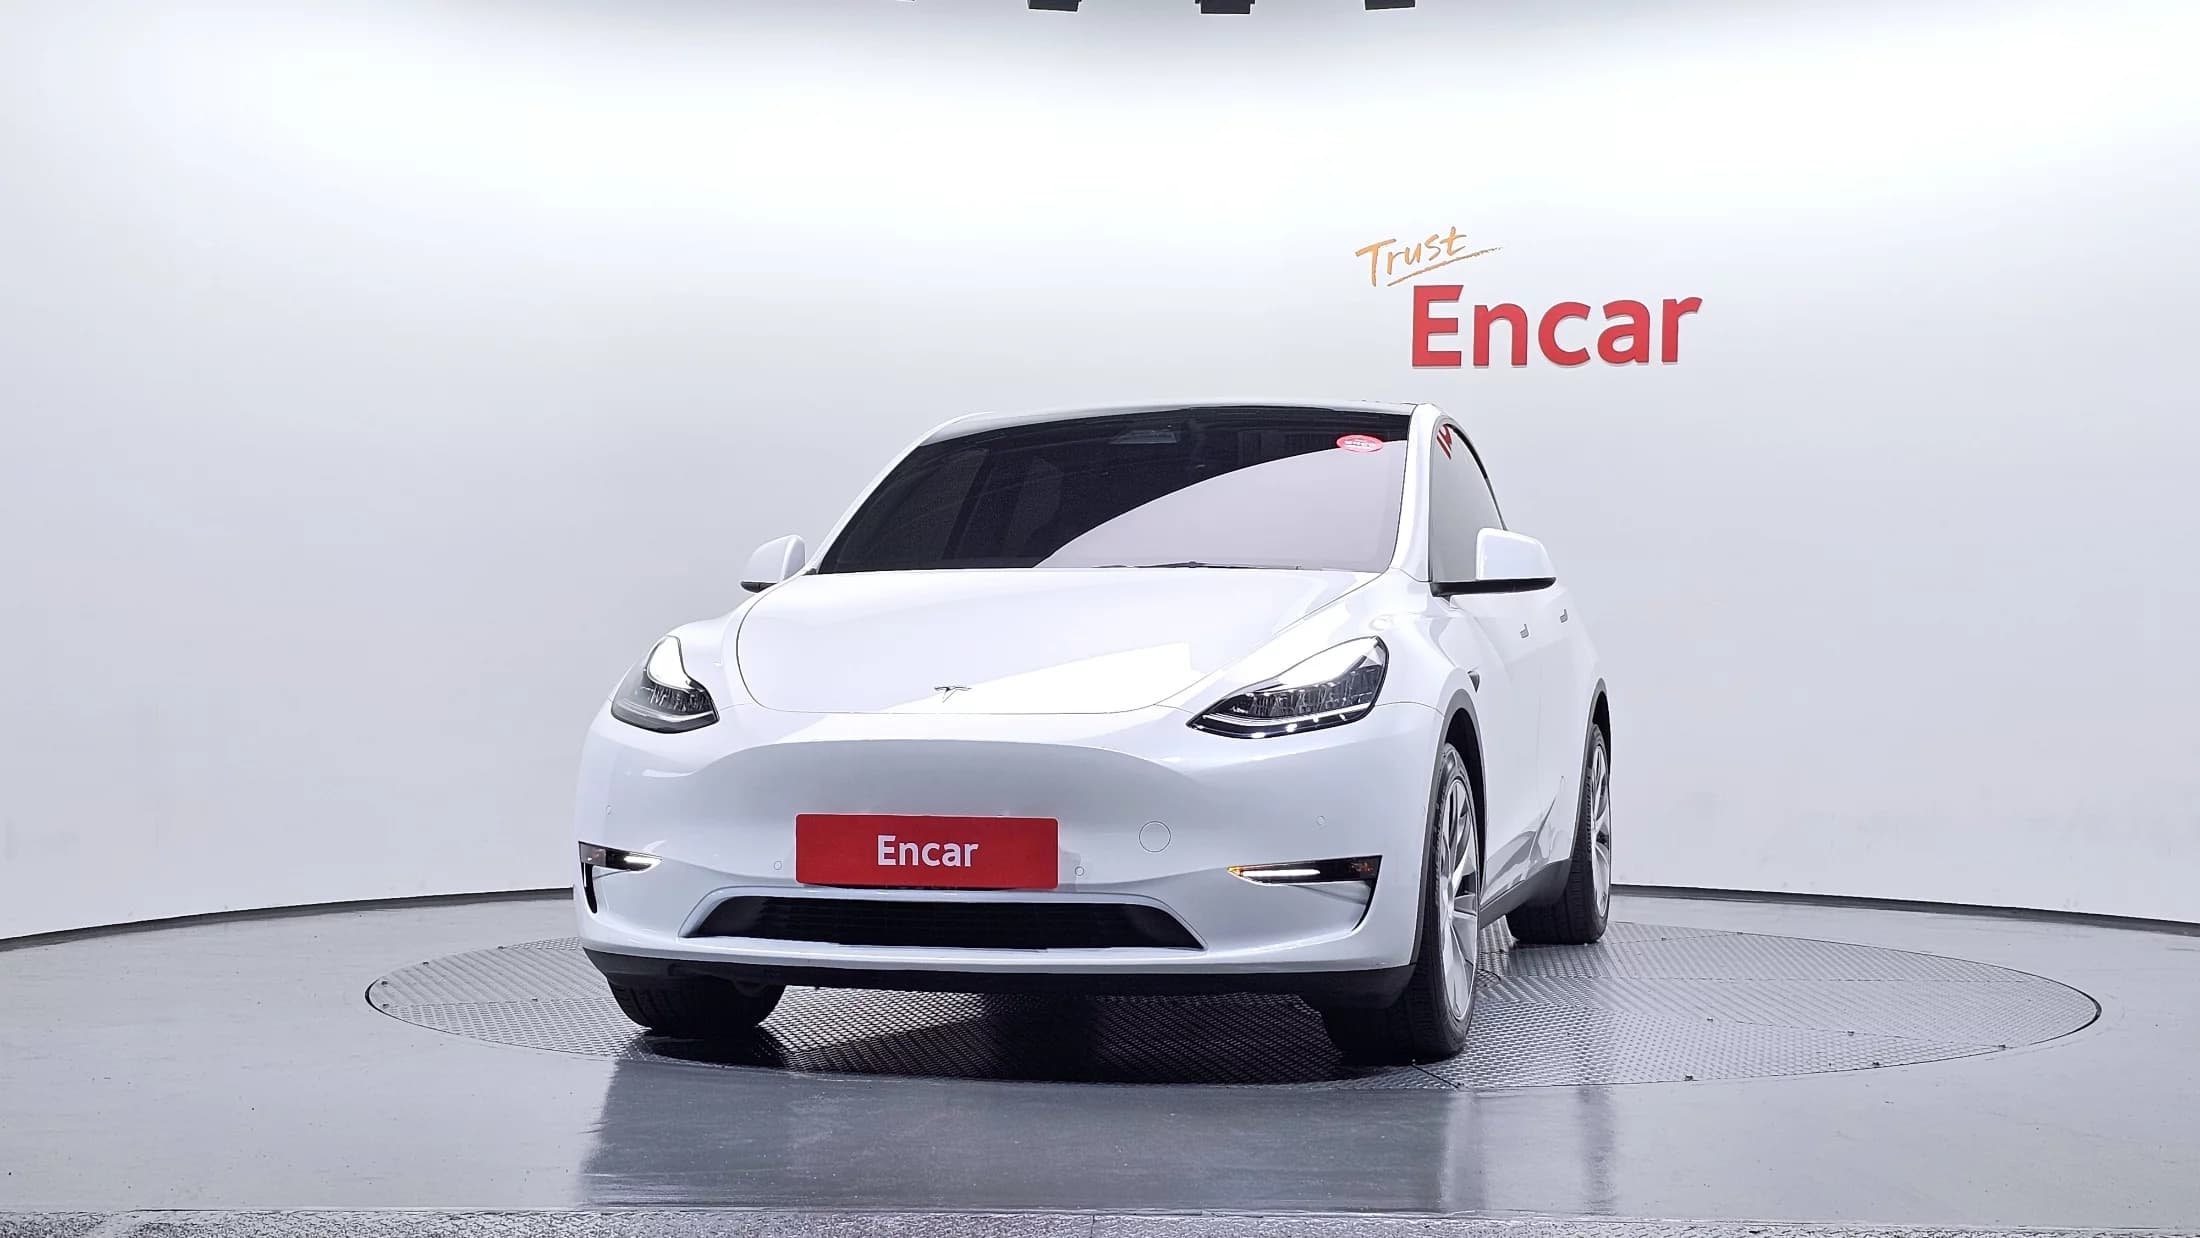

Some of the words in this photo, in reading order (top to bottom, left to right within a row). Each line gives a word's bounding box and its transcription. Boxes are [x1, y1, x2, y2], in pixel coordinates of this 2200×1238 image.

[1355, 226, 1467, 287] Trust
[1412, 285, 1703, 368] Encar
[877, 834, 979, 867] Encar
